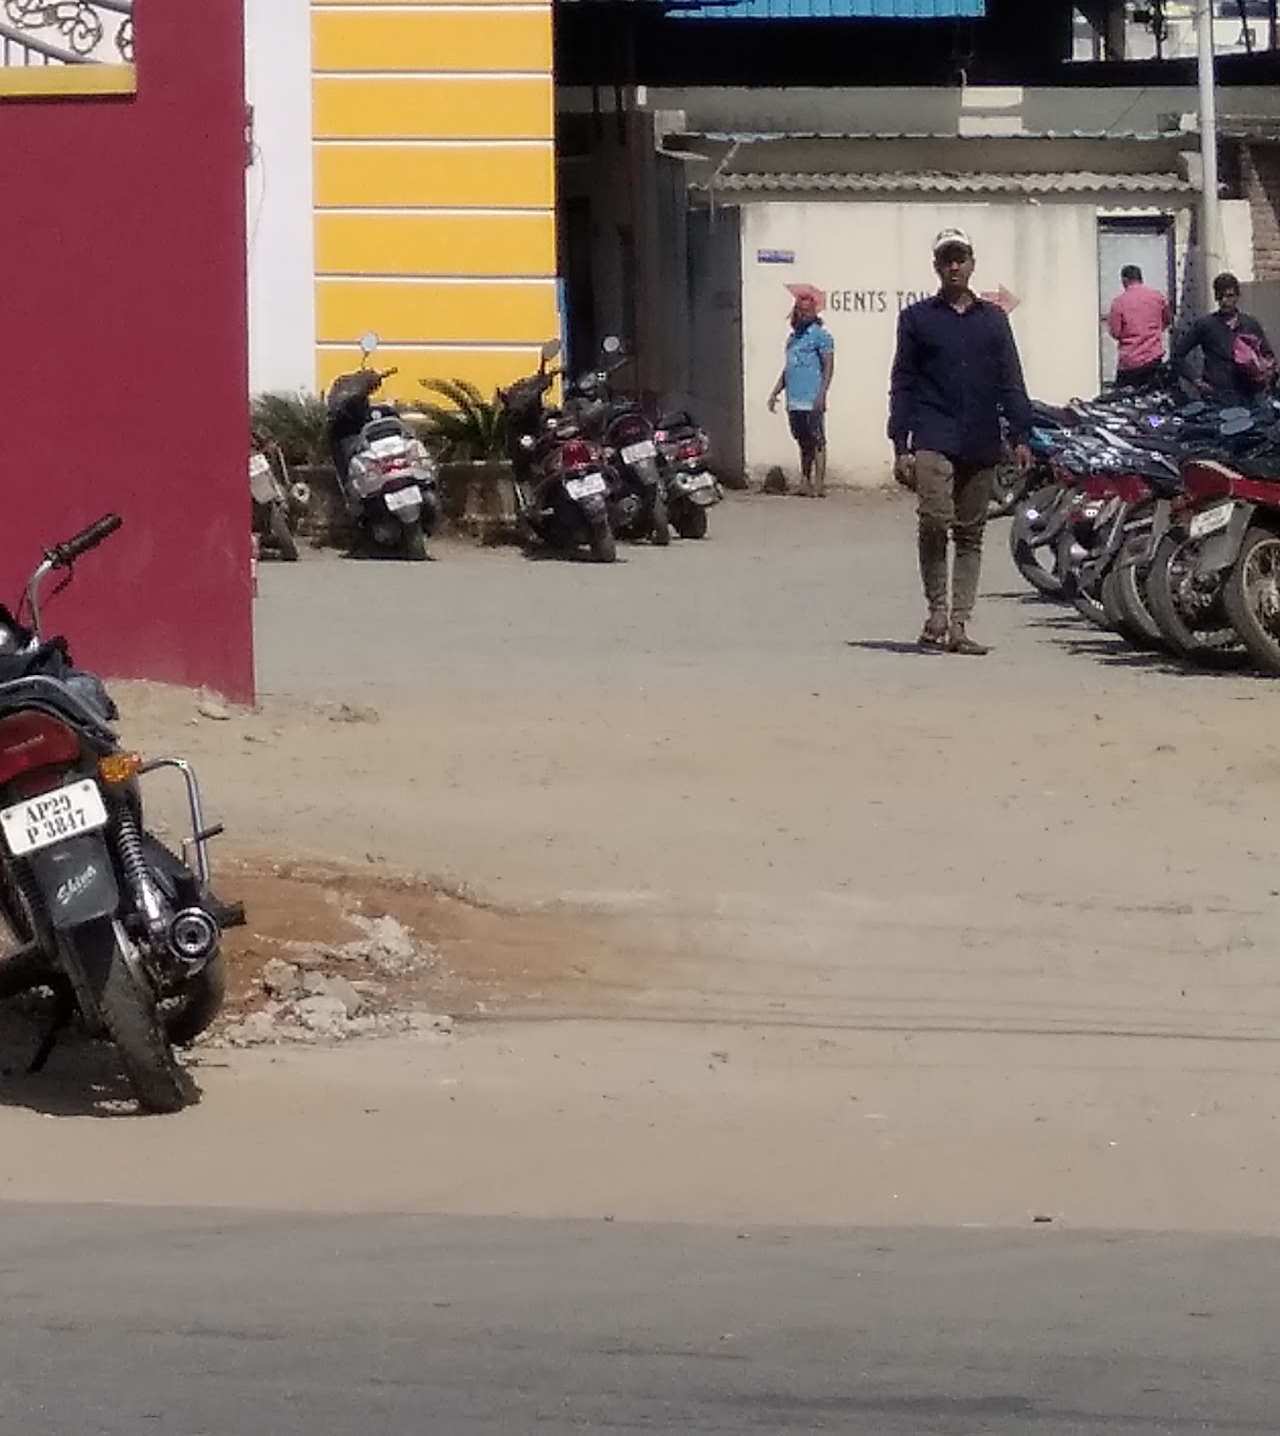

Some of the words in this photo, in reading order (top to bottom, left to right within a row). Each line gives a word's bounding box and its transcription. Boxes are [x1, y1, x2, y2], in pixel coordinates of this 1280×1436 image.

[831, 290, 886, 312] GENTS
[26, 795, 72, 822] AP29
[27, 826, 40, 845] P
[44, 809, 86, 838] 3847
